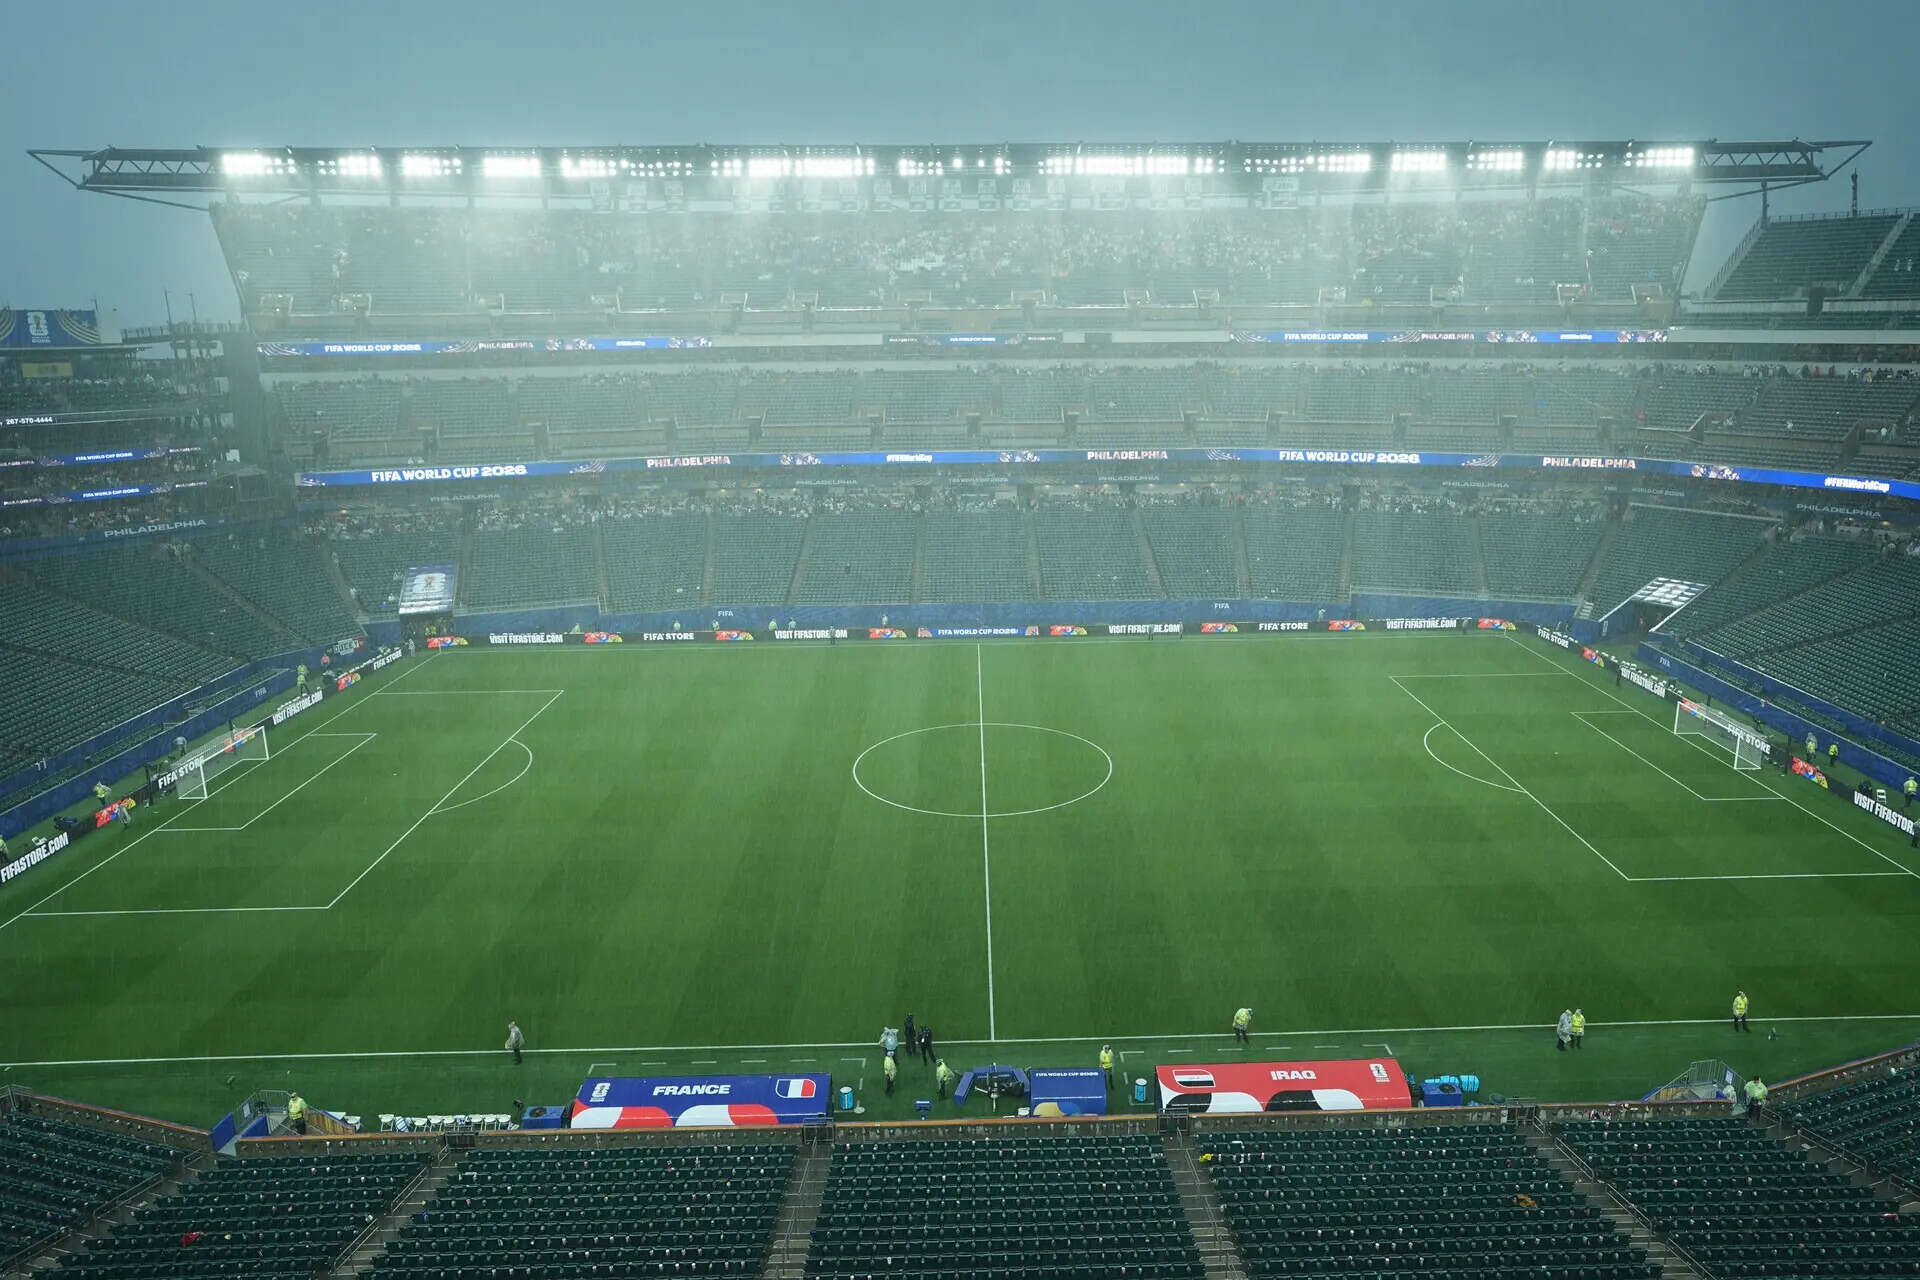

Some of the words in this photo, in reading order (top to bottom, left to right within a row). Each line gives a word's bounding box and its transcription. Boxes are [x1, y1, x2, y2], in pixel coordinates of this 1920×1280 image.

[1087, 450, 1168, 460] PHILADELPHIA
[1279, 450, 1304, 461] FIFA
[1305, 451, 1349, 462] WORLD
[1350, 452, 1376, 463] CUP
[1376, 452, 1421, 464] 2026
[646, 456, 731, 468] PHILADELPHIA
[1542, 456, 1636, 469] PHILADELPHIA
[371, 470, 401, 482] FIFA
[401, 468, 452, 481] WORLD
[452, 467, 480, 479] CUP
[480, 464, 528, 477] 2026
[1796, 503, 1882, 518] PHILADELPHIA
[104, 518, 207, 538] PHILADELPHIA
[1108, 625, 1127, 634] VISIT
[1258, 623, 1279, 631] FIFA
[1280, 622, 1309, 630] STORE
[1386, 620, 1404, 629] VISIT
[1404, 619, 1457, 629] FIFASTORE.COM
[489, 635, 508, 644] VISIT
[508, 634, 564, 644] FIFASTORE.COM
[643, 633, 665, 641] FIFA
[665, 632, 695, 640] STORE
[774, 630, 793, 640] VISIT
[937, 629, 953, 637] FIFA
[1537, 628, 1551, 641] FIFA
[1550, 634, 1569, 649] STORE
[373, 657, 386, 671] FIFA
[385, 649, 402, 664] STORE
[1660, 657, 1671, 668] FIFA
[255, 686, 268, 698] FIFA
[272, 709, 287, 726] VISIT
[1727, 723, 1745, 741] FIFA
[1745, 733, 1771, 756] STORE
[157, 770, 178, 790] FIFA
[1853, 790, 1875, 814] VISIT
[1874, 802, 1915, 836] FIFASTOR
[0, 831, 69, 884] FIFASTORE.COM
[1270, 1070, 1317, 1081] IRAQ
[652, 1084, 731, 1097] FRANCE
